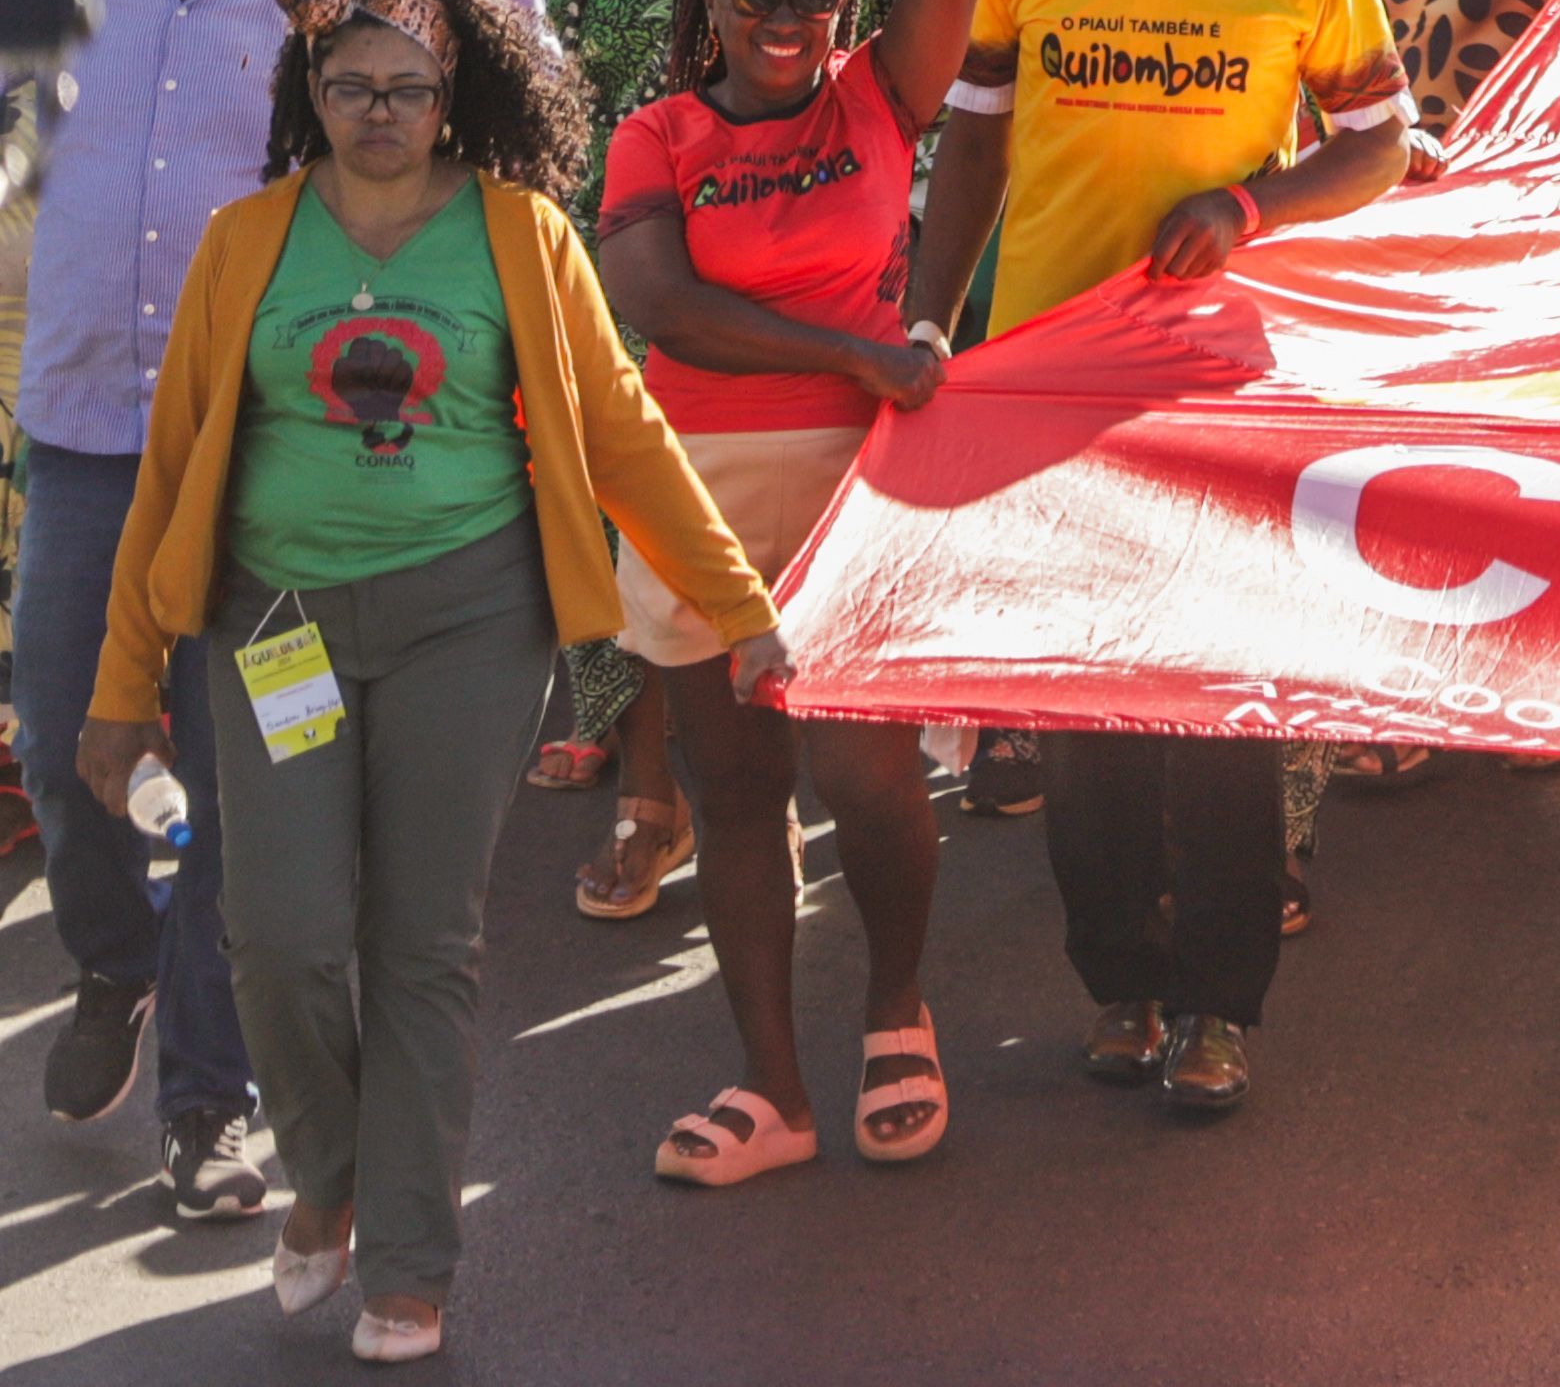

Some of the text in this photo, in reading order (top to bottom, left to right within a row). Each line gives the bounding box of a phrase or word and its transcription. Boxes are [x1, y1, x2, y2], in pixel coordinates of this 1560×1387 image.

[1062, 13, 1222, 39] O PIAUÍ TAMBÉM É
[1040, 30, 1251, 97] Quilombola
[693, 144, 863, 211] Quilombola
[355, 453, 416, 471] CONAQ
